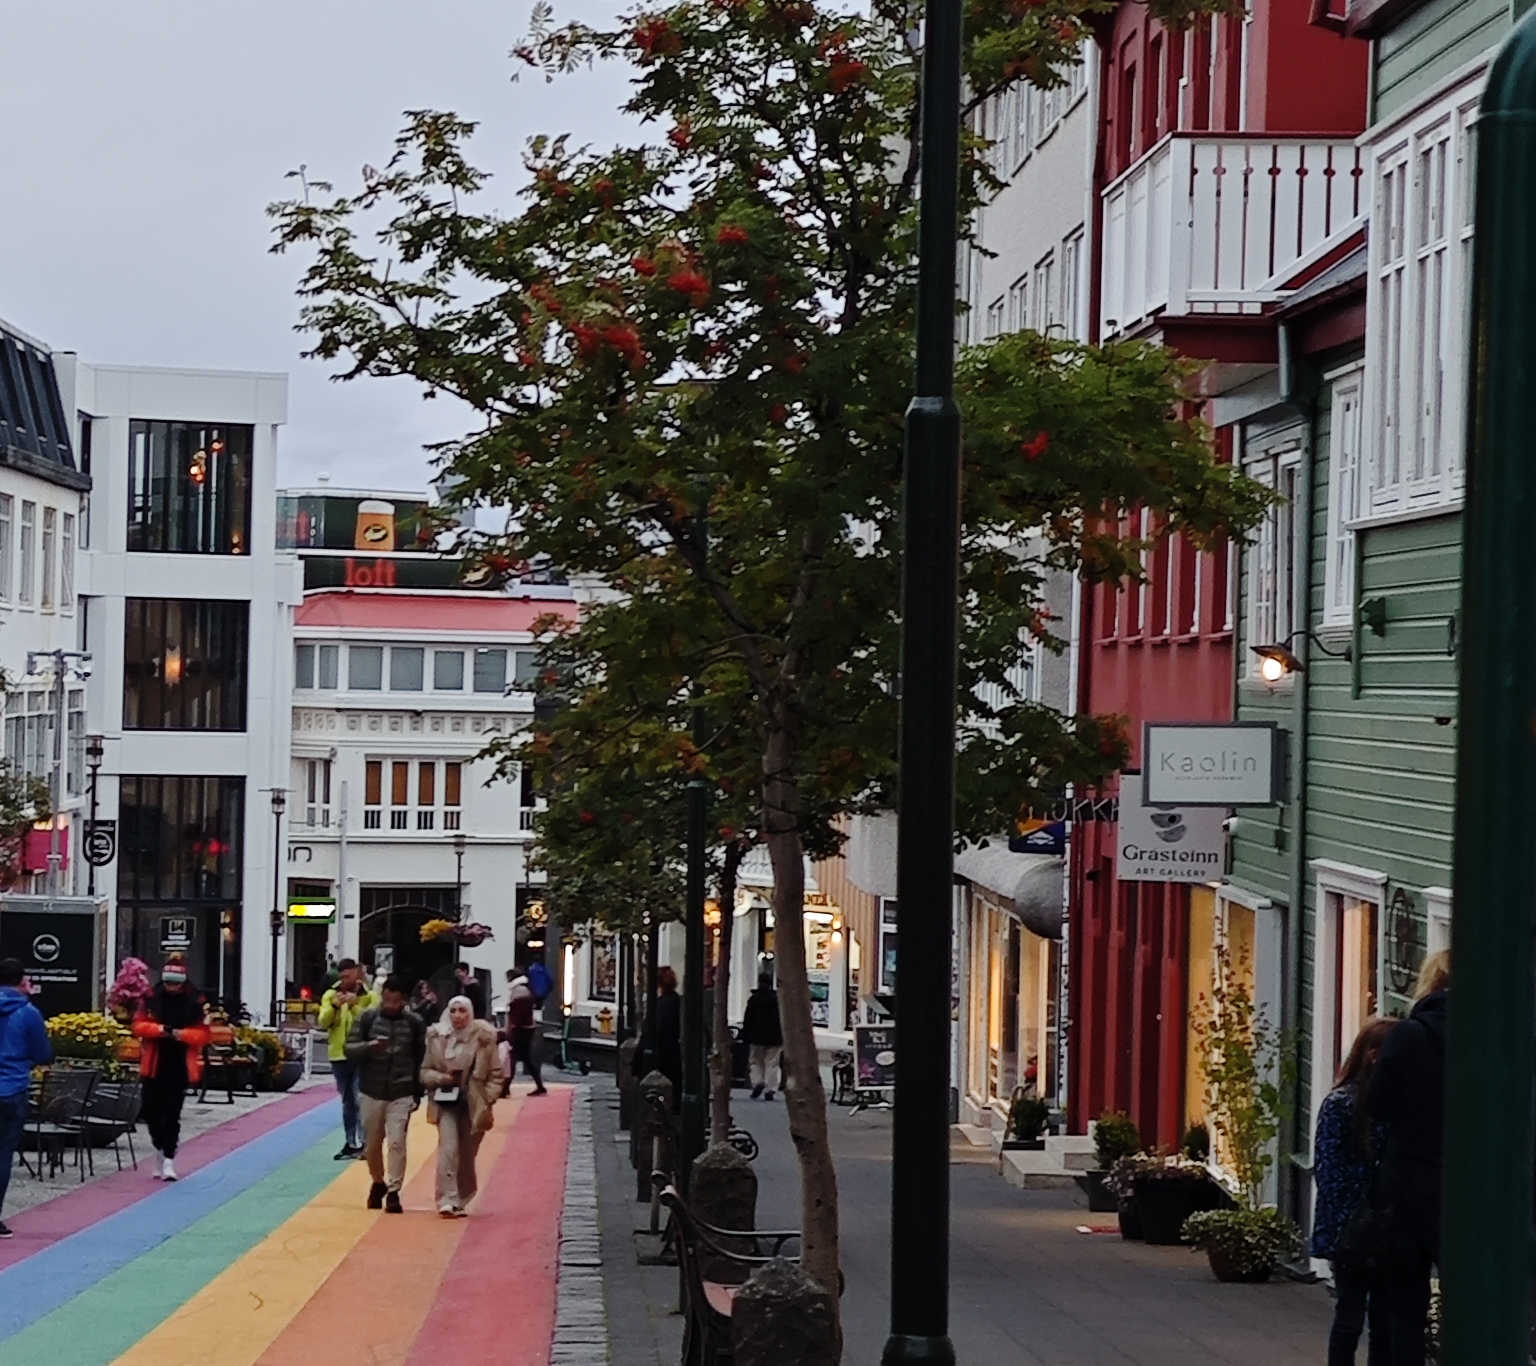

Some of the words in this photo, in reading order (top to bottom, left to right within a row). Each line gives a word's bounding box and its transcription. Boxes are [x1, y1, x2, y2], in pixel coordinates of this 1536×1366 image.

[344, 557, 397, 587] loft
[1160, 750, 1257, 773] Kaolin
[1122, 843, 1219, 863] Grásteinn
[1136, 867, 1155, 875] ART
[1159, 868, 1206, 877] GALLERY
